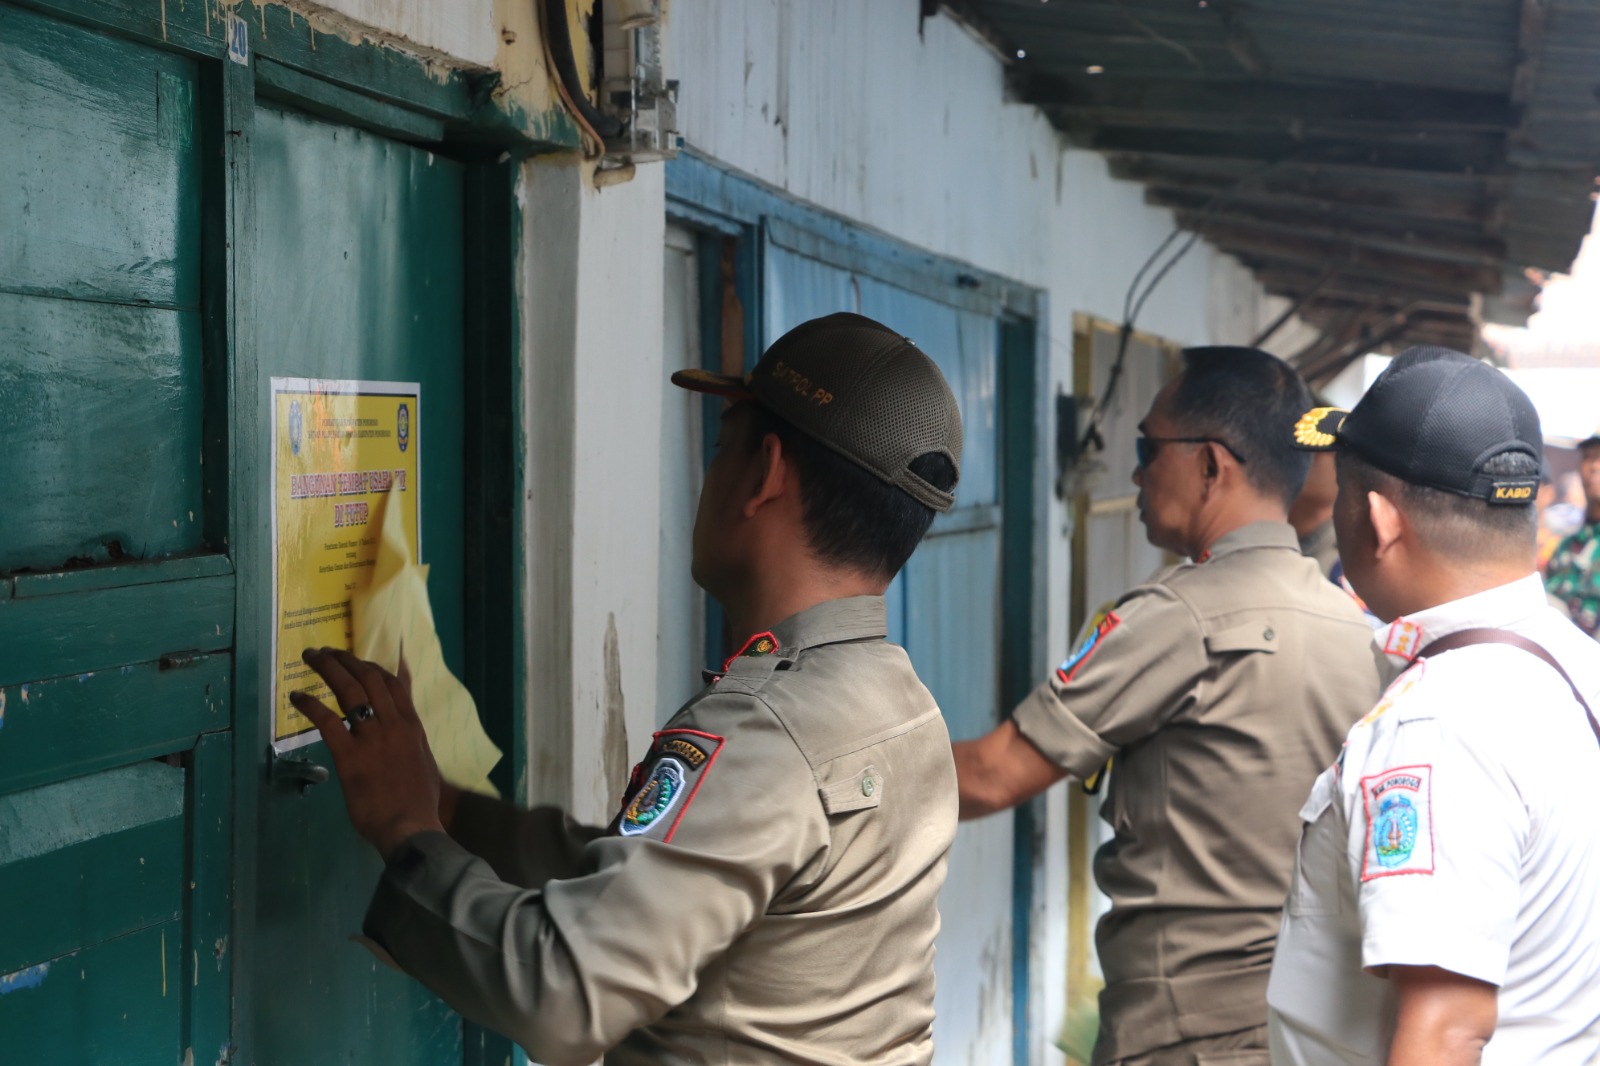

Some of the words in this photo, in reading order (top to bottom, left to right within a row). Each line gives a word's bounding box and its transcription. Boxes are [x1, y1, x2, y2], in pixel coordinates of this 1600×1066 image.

[230, 17, 247, 58] 20
[811, 388, 833, 406] PP
[290, 474, 337, 498] BANGUNAN
[338, 471, 367, 496] TEMPAT
[1496, 487, 1532, 499] KABID
[334, 504, 344, 528] DI
[345, 502, 368, 526] TUTUP
